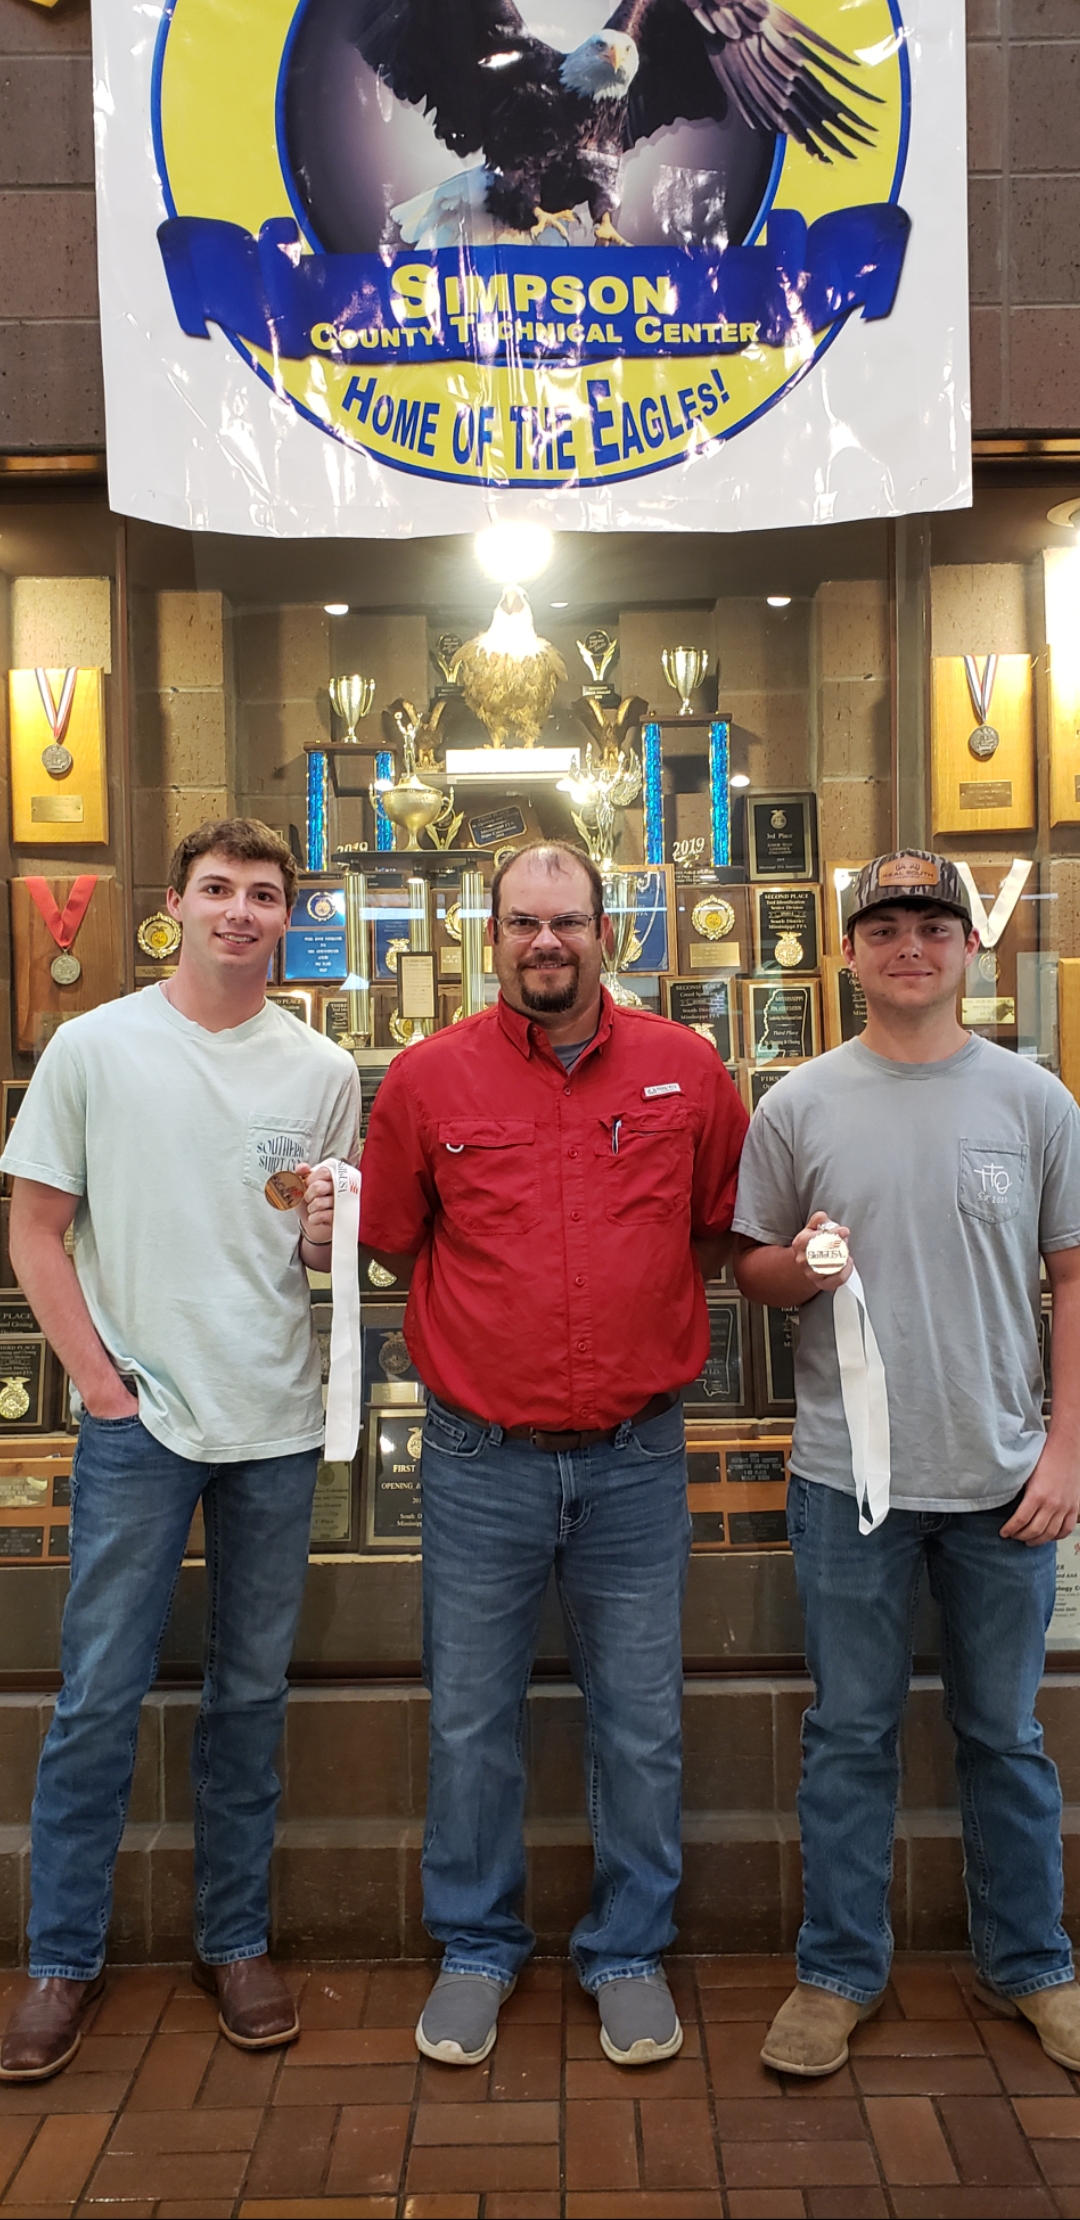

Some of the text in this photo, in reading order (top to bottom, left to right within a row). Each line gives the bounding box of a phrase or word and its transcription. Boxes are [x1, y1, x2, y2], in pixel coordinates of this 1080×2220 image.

[391, 263, 677, 318] SIMPSON
[310, 315, 760, 351] COUNTY TECHNICAL CENTER
[341, 368, 731, 471] HOME OF THE EAGLES!
[672, 837, 705, 861] 2019
[3, 1312, 33, 1320] PLACE
[393, 1464, 417, 1473] FIRST
[381, 1482, 414, 1490] OPENING
